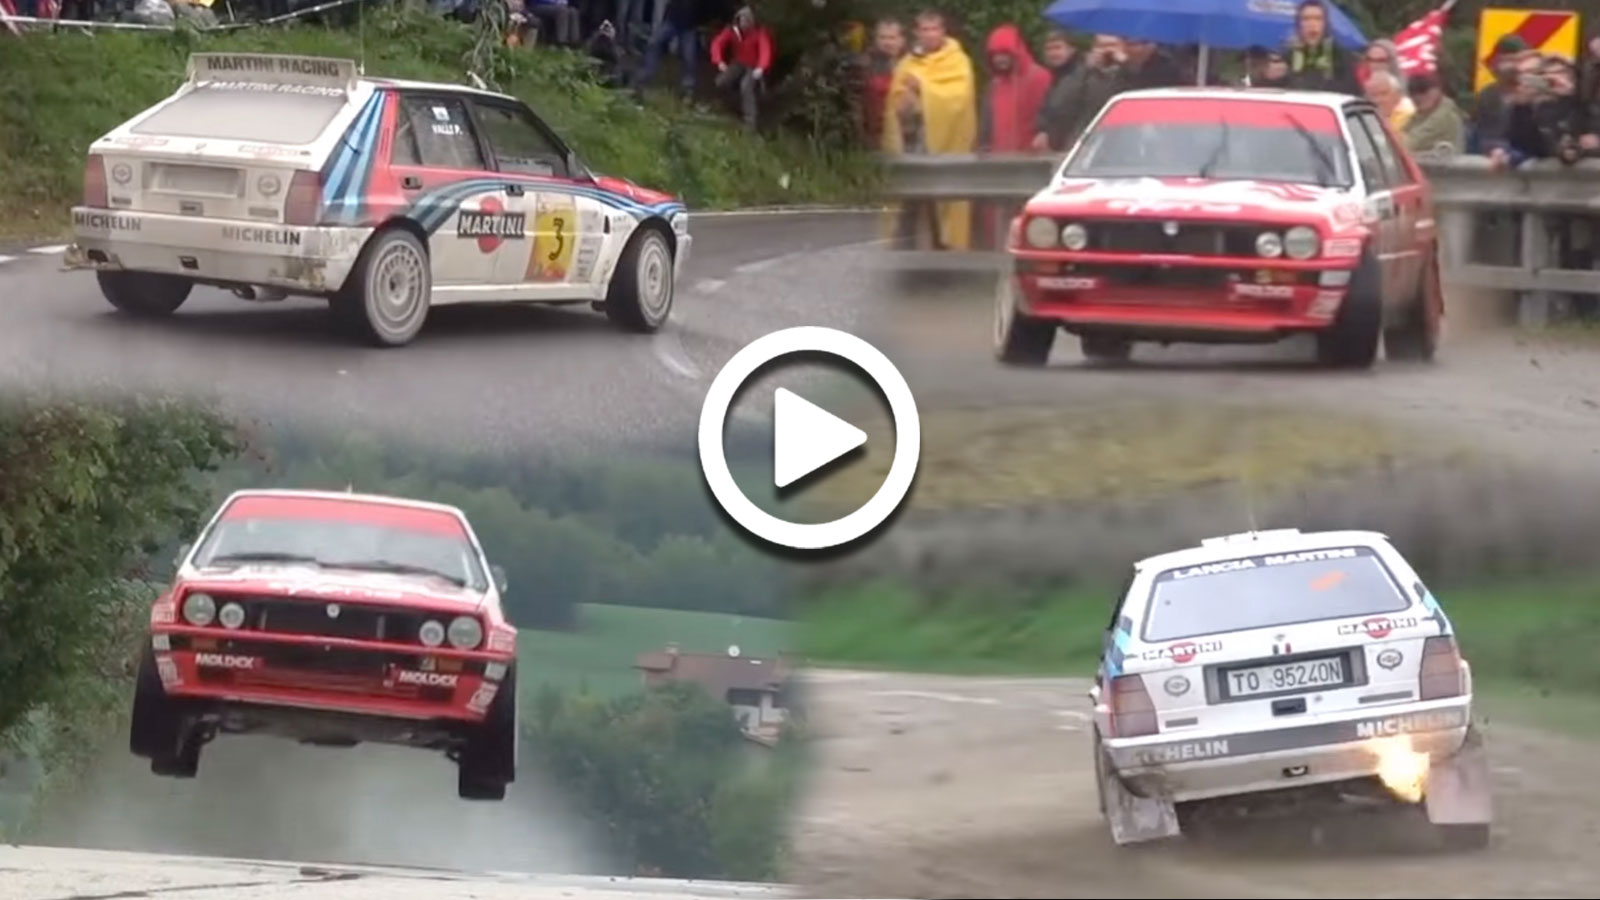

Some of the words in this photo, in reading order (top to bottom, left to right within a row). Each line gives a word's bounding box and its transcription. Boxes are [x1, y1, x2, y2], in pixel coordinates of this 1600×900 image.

[208, 56, 274, 72] MARTINI
[279, 60, 340, 77] RACING
[74, 212, 142, 232] MICHELIN
[459, 213, 525, 236] MARTINI
[221, 226, 301, 246] MICHELIN
[548, 217, 565, 261] 3
[1173, 558, 1257, 579] LANCIA
[1264, 548, 1357, 566] MARTINI
[1337, 616, 1418, 636] MARTINI
[1142, 640, 1223, 661] MARTINI
[1273, 660, 1343, 688] 95240N
